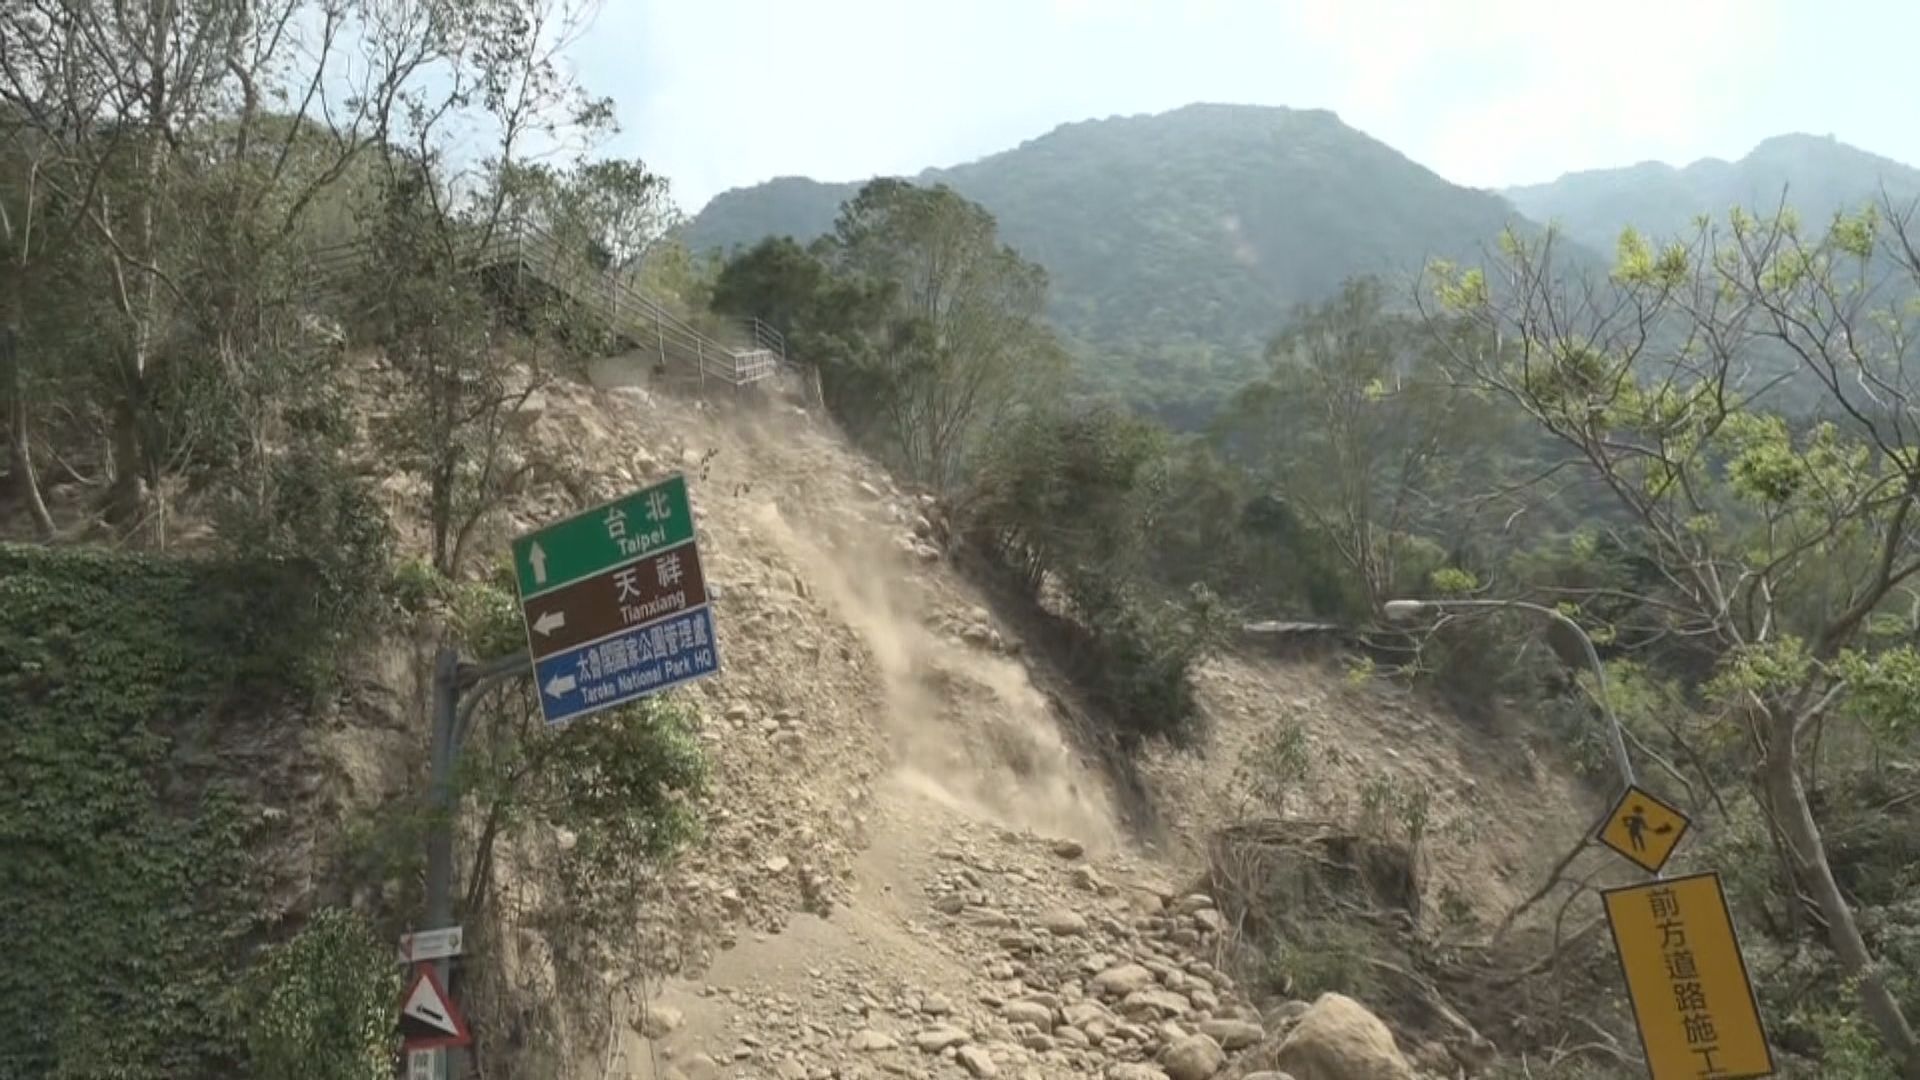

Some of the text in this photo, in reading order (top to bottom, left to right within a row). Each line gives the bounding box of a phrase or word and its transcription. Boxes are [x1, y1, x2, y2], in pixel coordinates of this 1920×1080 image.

[605, 491, 671, 538] 台北
[618, 526, 665, 555] Taipei
[613, 553, 683, 602] 天祥
[620, 590, 686, 624] Tianxiang
[618, 668, 661, 689] National
[665, 655, 691, 679] Park
[694, 648, 711, 670] HQ
[1648, 887, 1726, 1077] 前方道路施工
